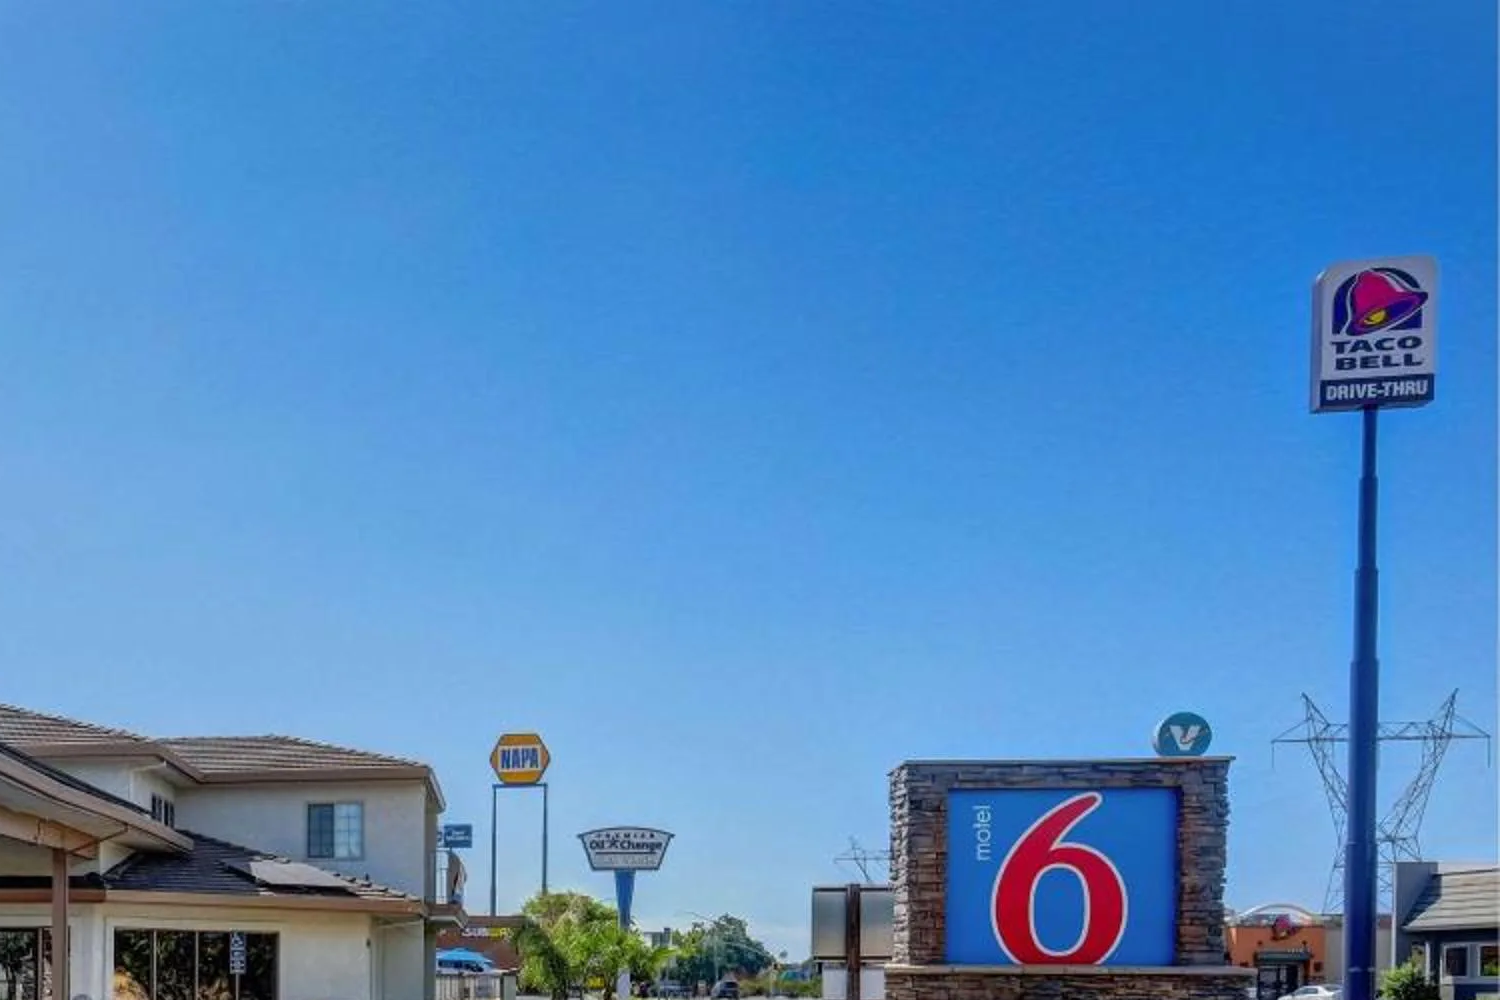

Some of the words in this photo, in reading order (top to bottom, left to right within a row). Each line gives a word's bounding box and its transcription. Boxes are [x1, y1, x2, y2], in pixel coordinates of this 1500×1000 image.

[1330, 335, 1422, 354] TACO
[1335, 353, 1424, 371] BELL
[1326, 379, 1429, 400] DRIVE-THRU
[501, 747, 539, 769] NAPA
[972, 805, 991, 861] motel
[620, 840, 663, 853] Change
[990, 791, 1128, 965] 6
